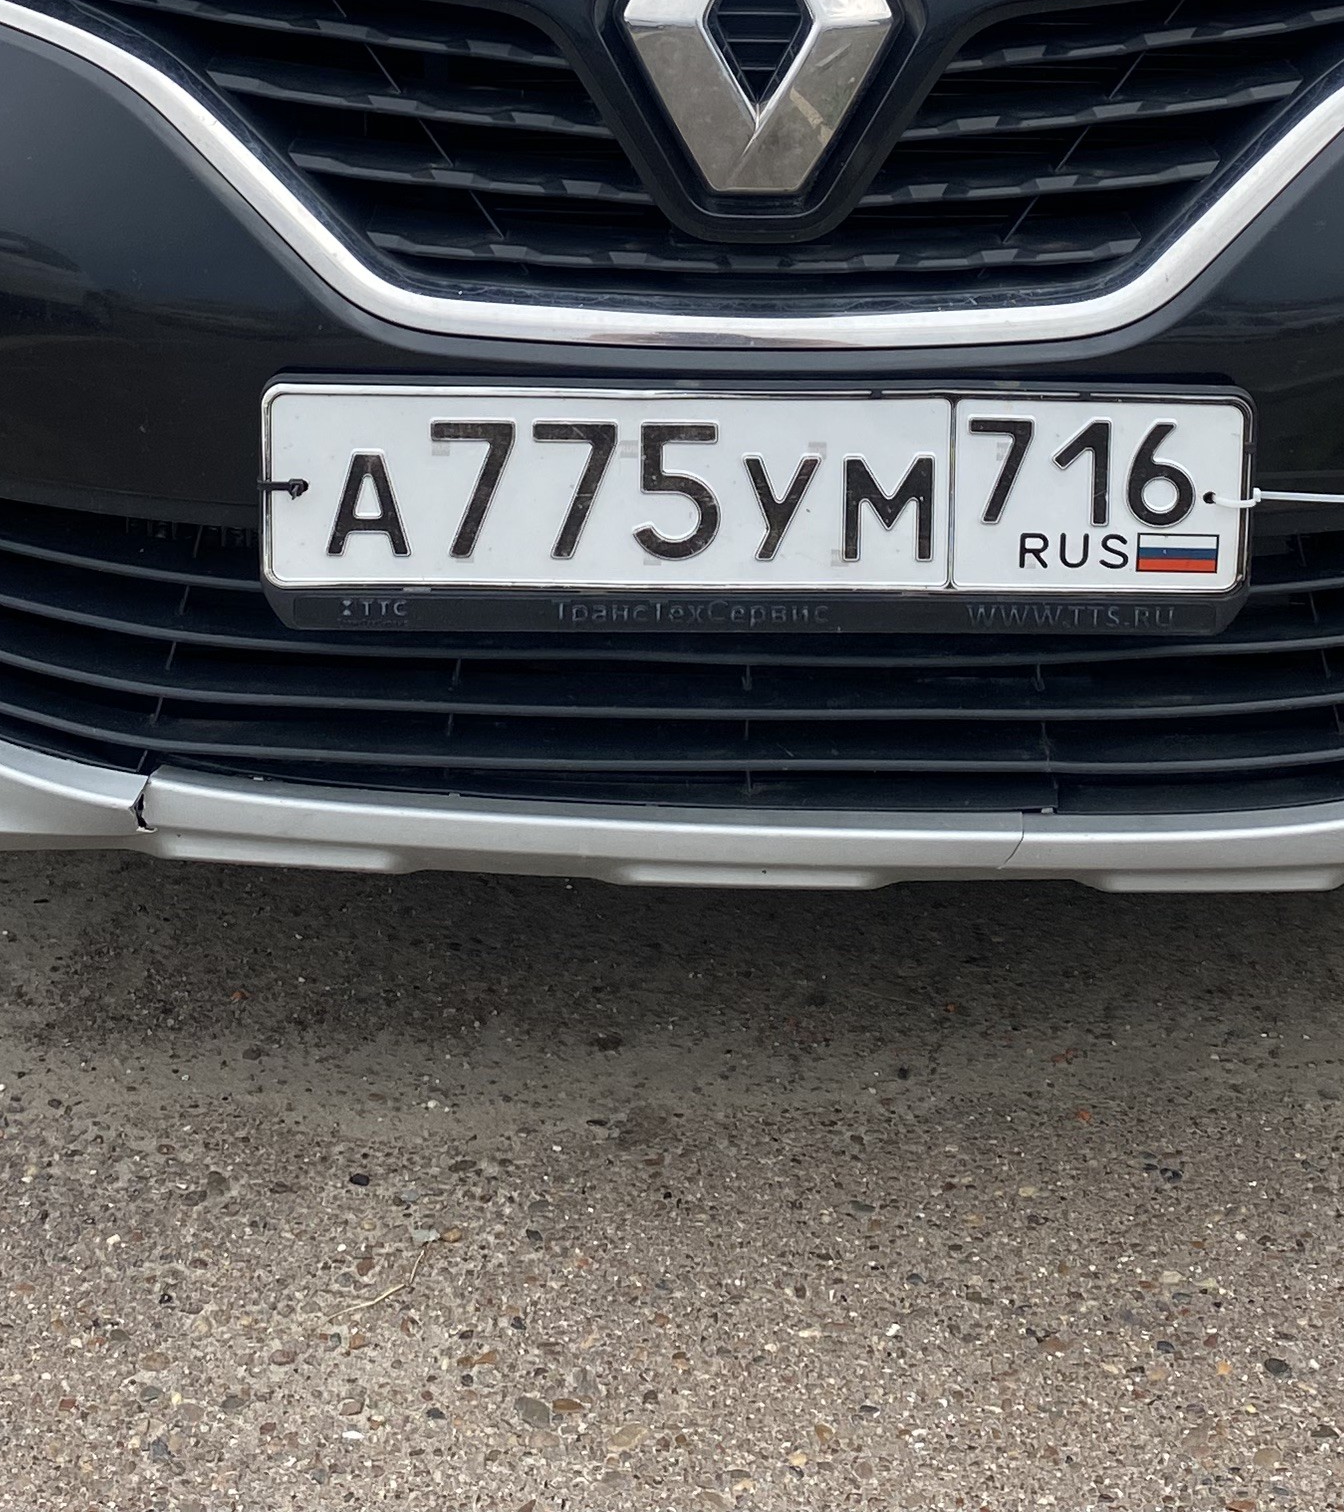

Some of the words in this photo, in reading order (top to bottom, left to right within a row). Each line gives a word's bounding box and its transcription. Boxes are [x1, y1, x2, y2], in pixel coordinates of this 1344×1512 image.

[326, 420, 935, 562] А775УМ
[968, 417, 1197, 528] 716
[1018, 532, 1130, 570] RUS
[552, 599, 830, 626] ТрансТехСервис
